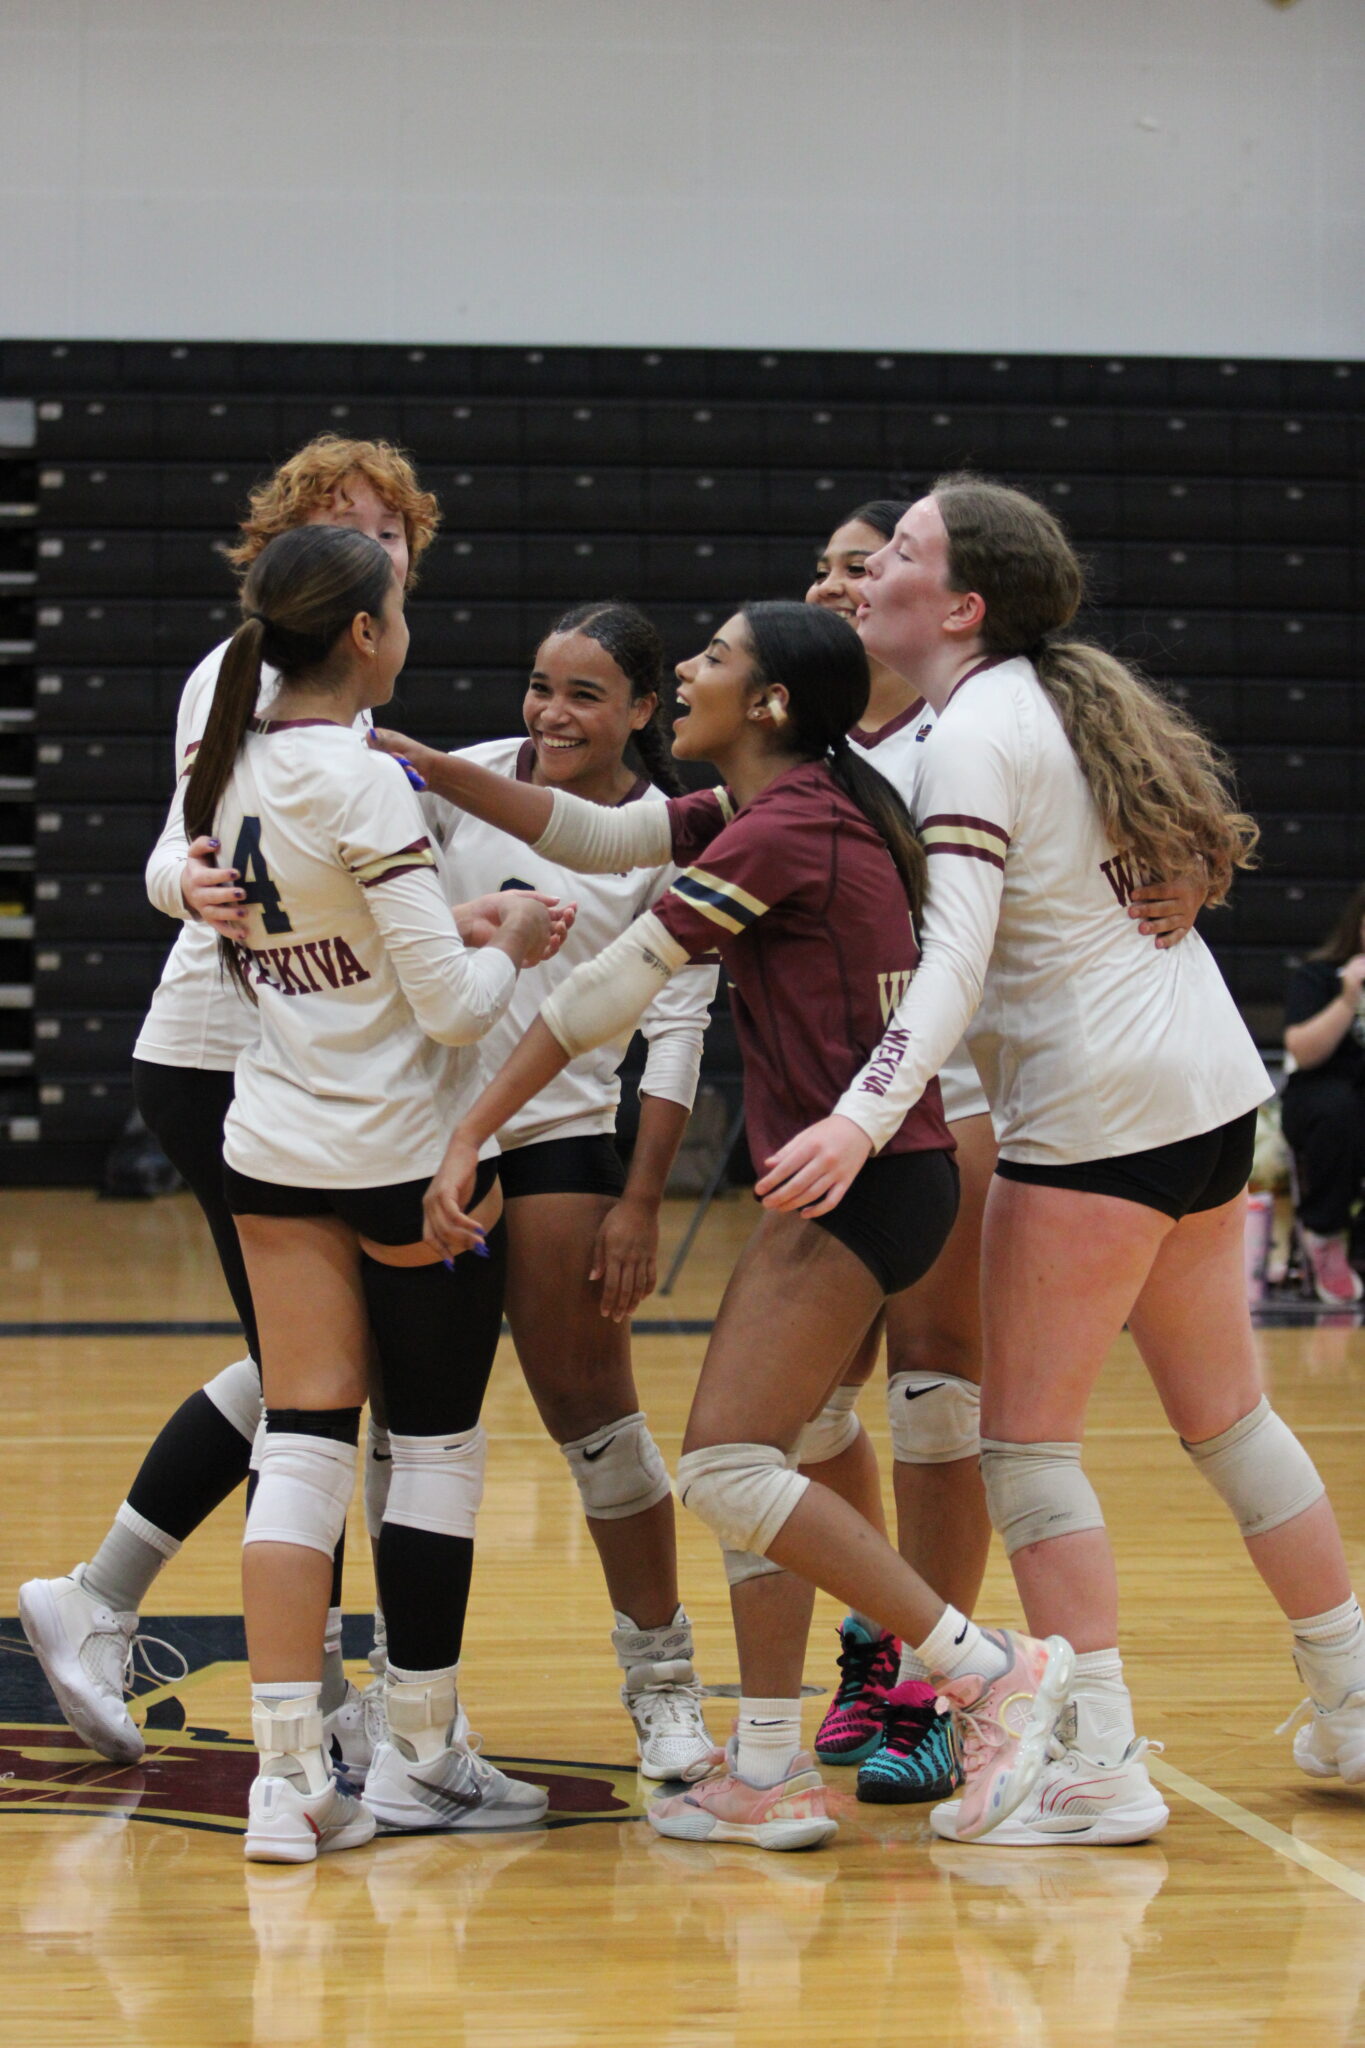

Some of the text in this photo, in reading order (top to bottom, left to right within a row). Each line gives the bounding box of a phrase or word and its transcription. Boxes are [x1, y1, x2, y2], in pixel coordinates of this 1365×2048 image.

[232, 815, 294, 935] 4
[234, 936, 372, 996] EKIVA
[857, 1028, 912, 1098] WEKIVA
